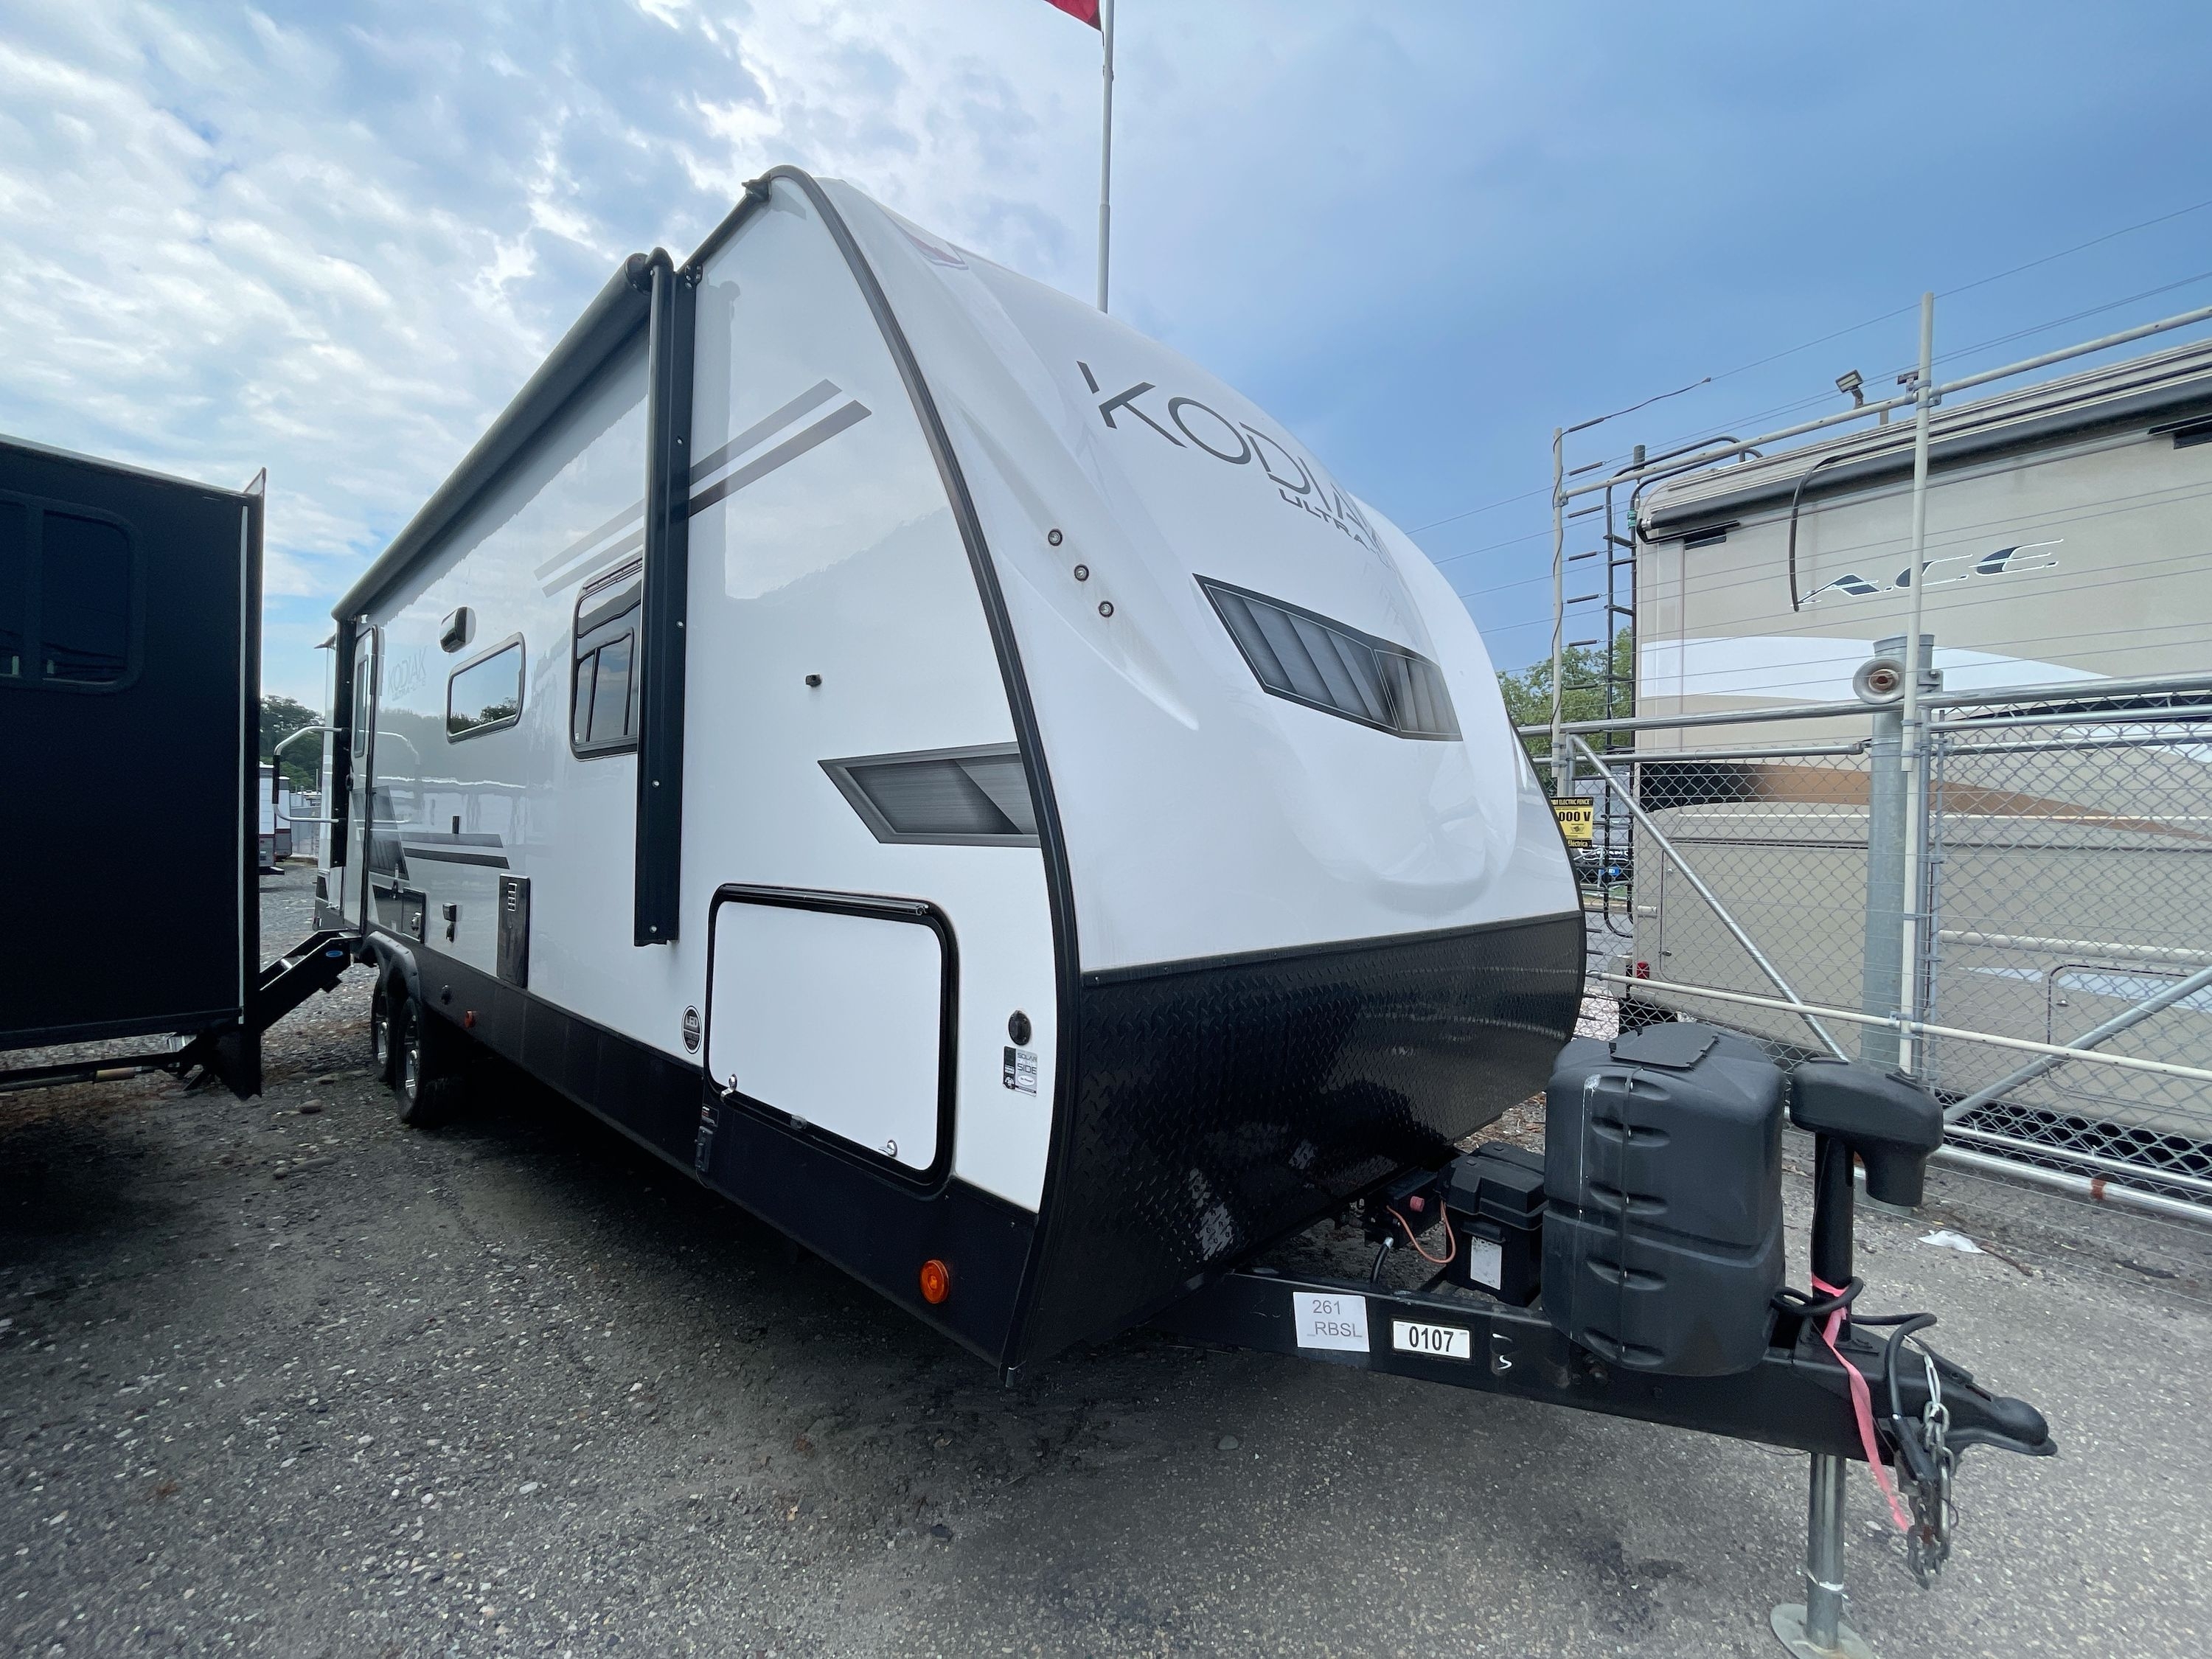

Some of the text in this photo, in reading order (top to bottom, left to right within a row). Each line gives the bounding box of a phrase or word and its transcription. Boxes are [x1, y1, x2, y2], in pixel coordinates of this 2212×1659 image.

[1583, 811, 1591, 821] V
[686, 1015, 698, 1028] LED
[1018, 1052, 1037, 1062] SOLAR
[1018, 1063, 1037, 1075] SIDE
[1313, 1300, 1341, 1315] 261
[1408, 1325, 1454, 1352] 0107
